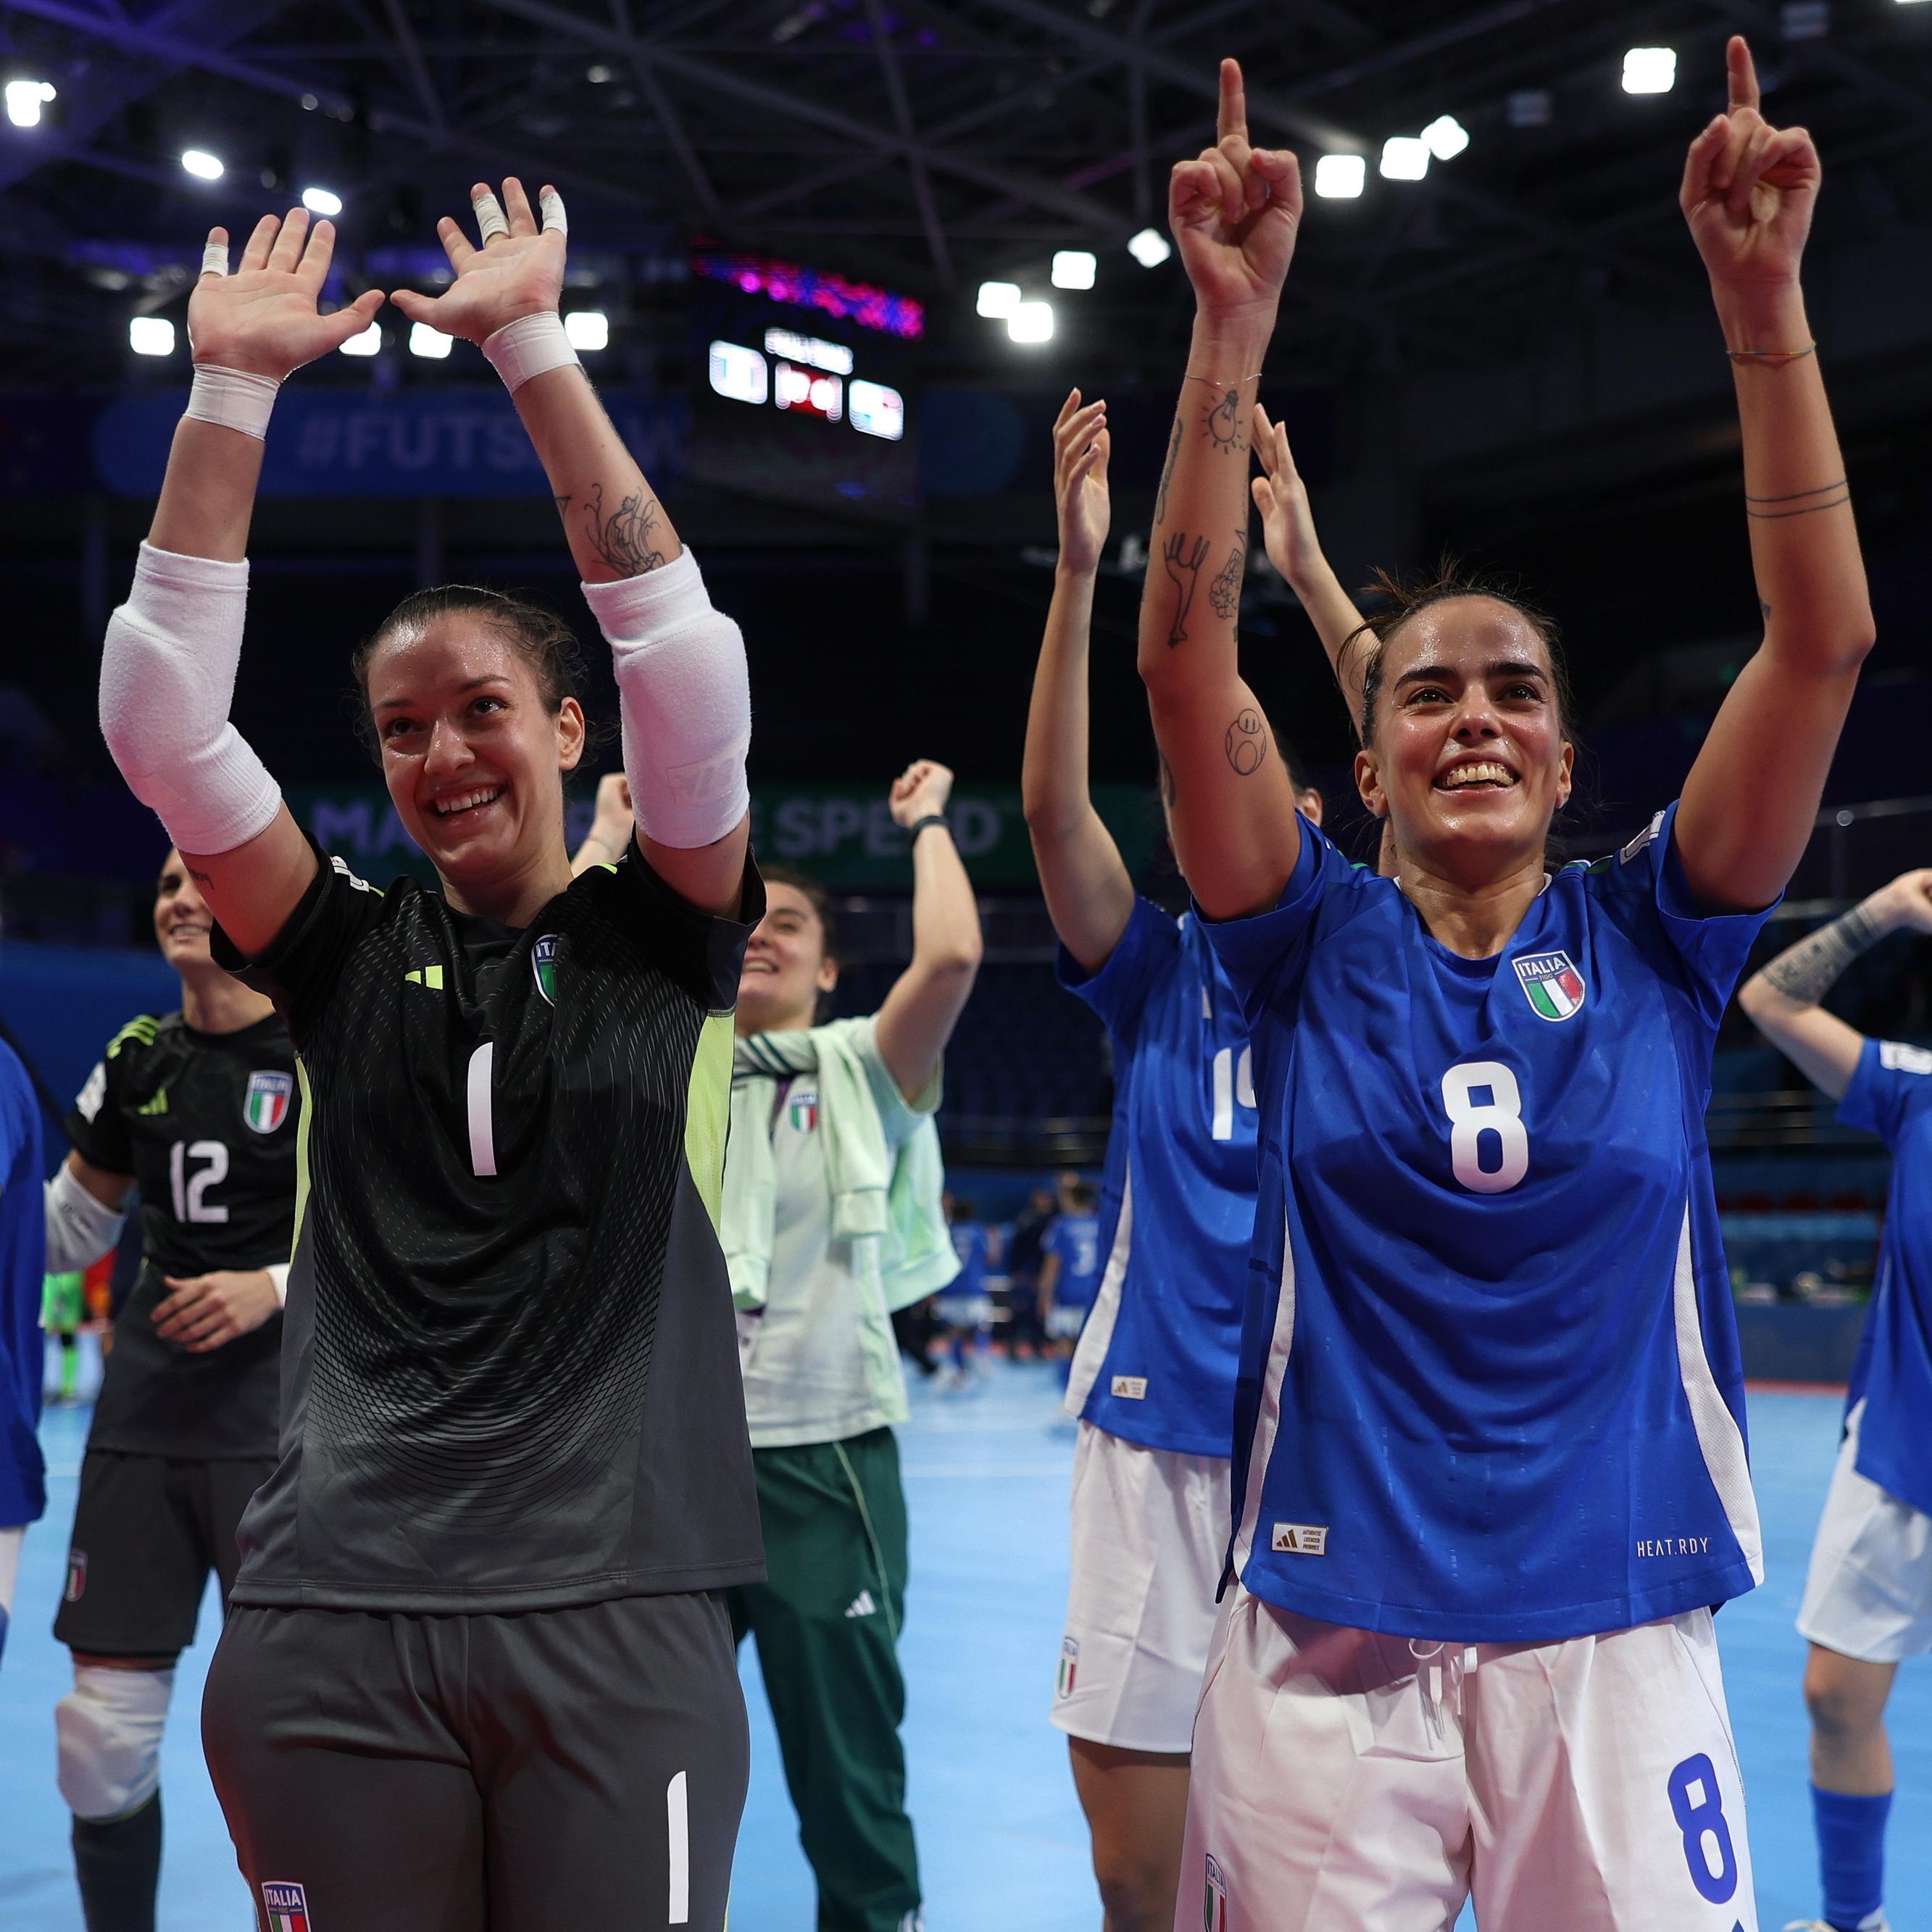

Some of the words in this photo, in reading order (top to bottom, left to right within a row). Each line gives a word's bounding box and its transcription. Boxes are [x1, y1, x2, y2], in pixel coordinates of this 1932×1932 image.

[773, 798, 1002, 858] SPED
[1517, 957, 1566, 977] ITALIA
[467, 1041, 497, 1176] 1
[1441, 1061, 1529, 1194] 8
[170, 1140, 230, 1223] 12
[1637, 1537, 1708, 1557] HEAT.RDY
[667, 1770, 689, 1924] 1
[1667, 1752, 1738, 1904] 8
[265, 1889, 301, 1907] ITALIA
